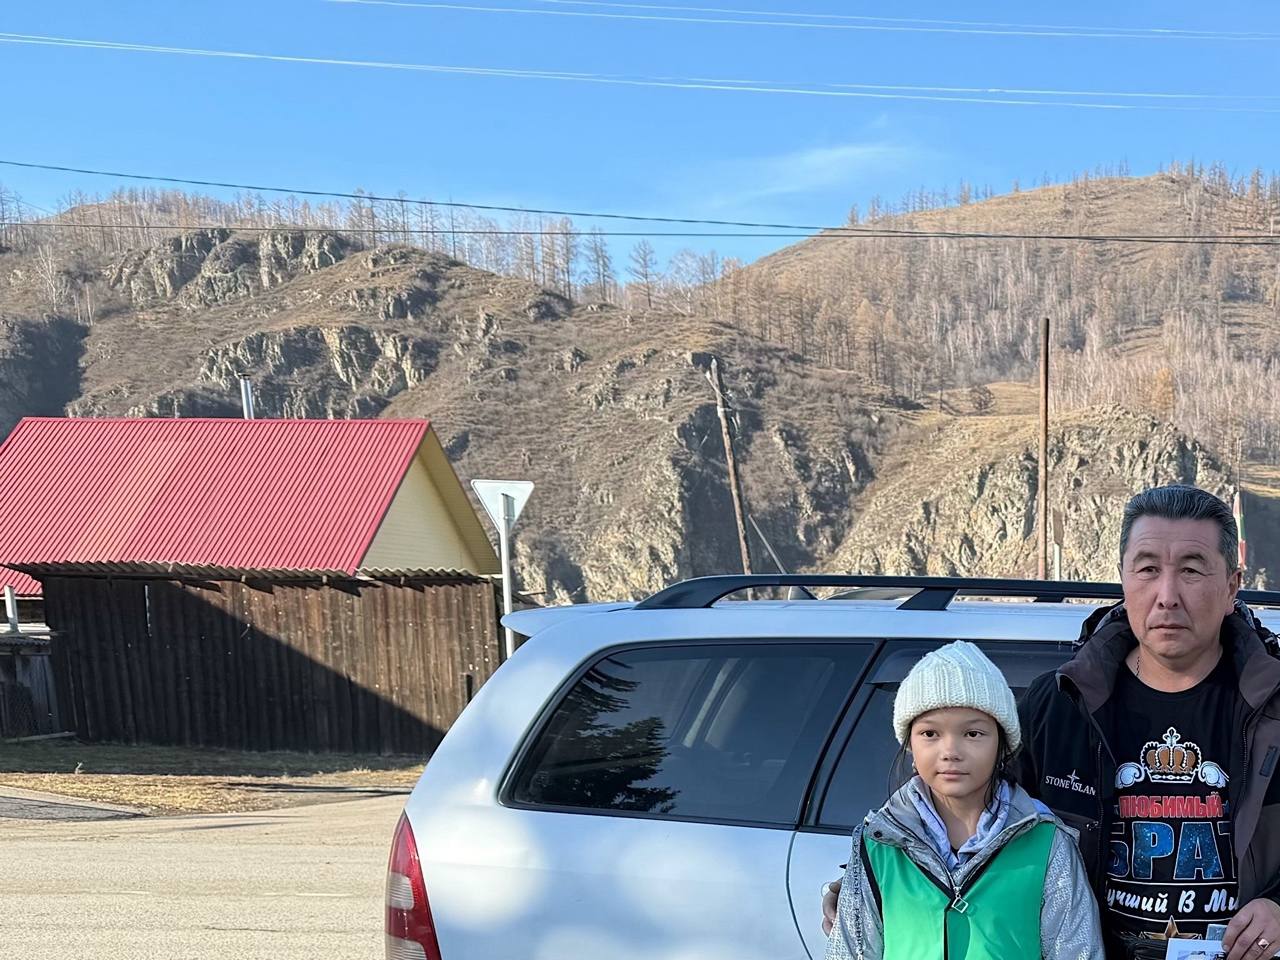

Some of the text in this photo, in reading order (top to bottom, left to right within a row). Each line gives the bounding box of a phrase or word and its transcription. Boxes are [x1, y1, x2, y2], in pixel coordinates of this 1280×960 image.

[1045, 775, 1097, 796] STONE ISLAN
[1120, 791, 1224, 819] ЛЮБИМЫЙ
[1107, 888, 1240, 914] учший В Ми
